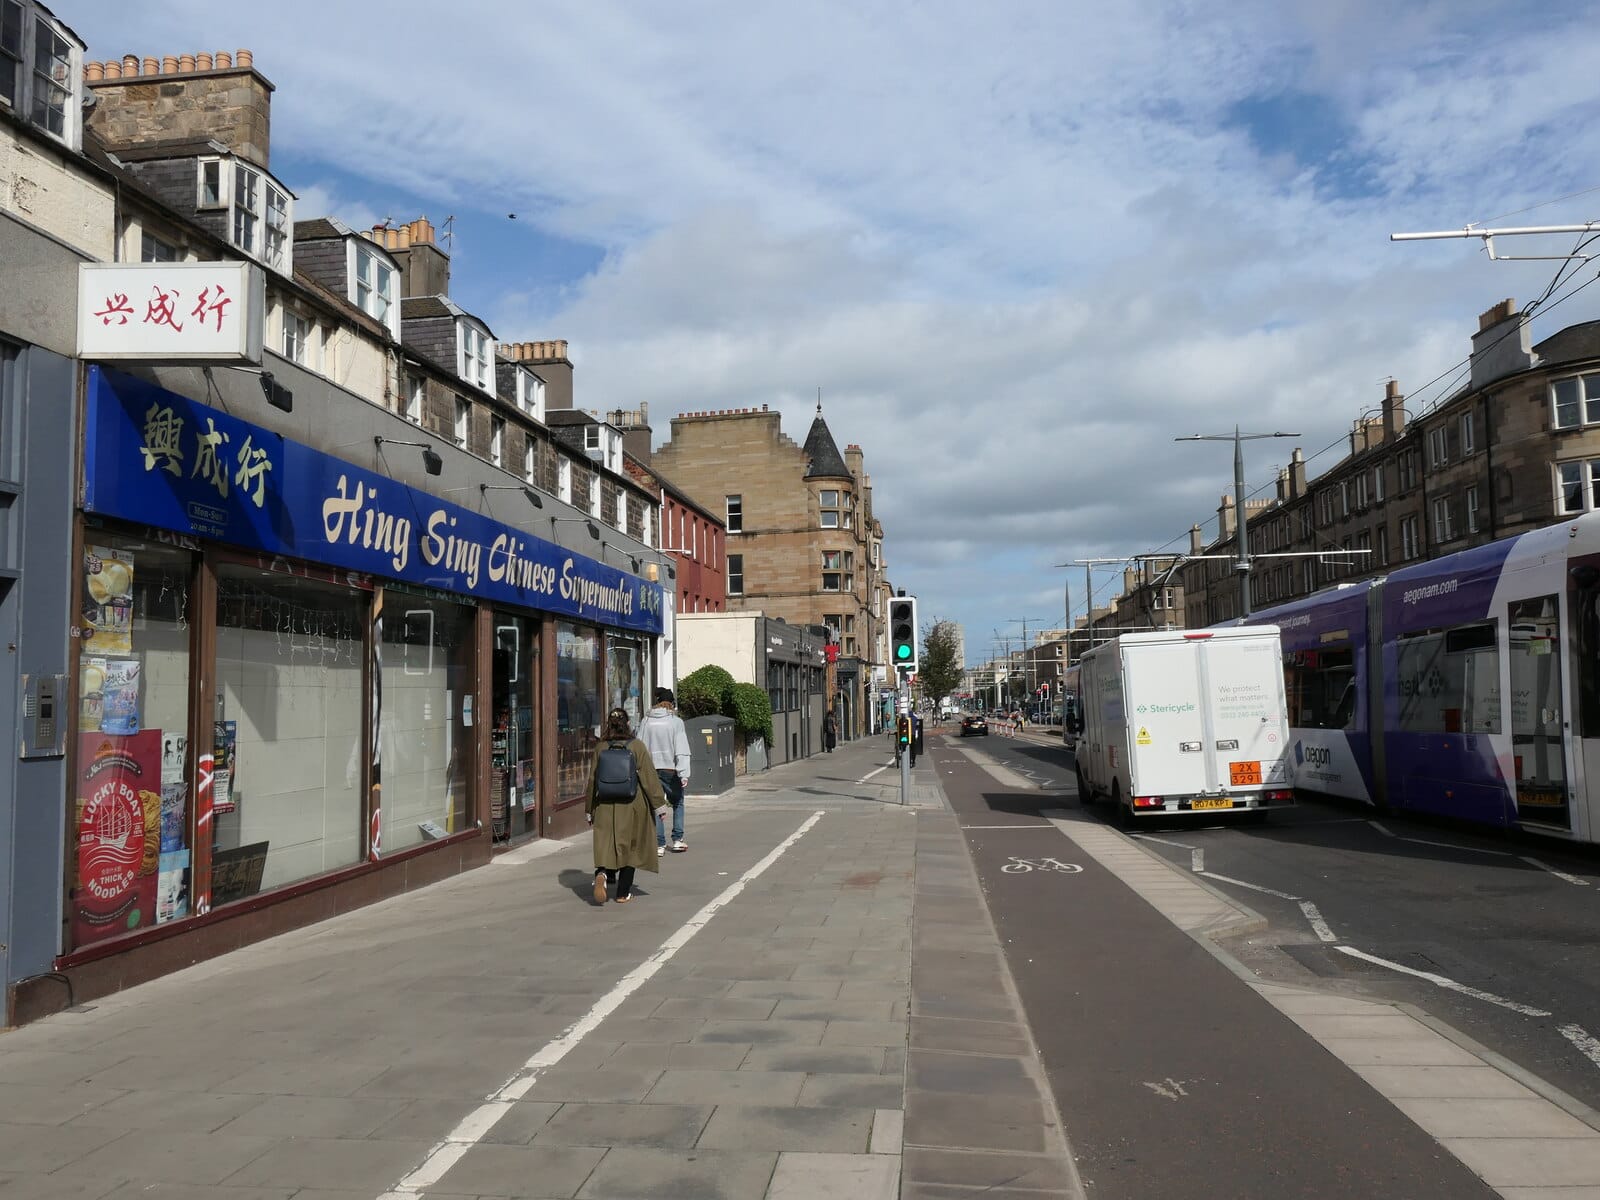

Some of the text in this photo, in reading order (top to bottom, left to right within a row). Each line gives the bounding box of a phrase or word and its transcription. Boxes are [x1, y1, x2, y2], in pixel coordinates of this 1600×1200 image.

[94, 284, 233, 333] 兴成行
[139, 401, 273, 509] 興成行
[322, 474, 633, 616] Hing Sing Chinese Supermarket
[1403, 577, 1458, 605] aegonam.com
[1232, 684, 1261, 694] protect
[1150, 702, 1195, 714] Stericycle
[1239, 763, 1253, 773] 2X
[1305, 746, 1331, 769] aegon
[1232, 774, 1261, 784] 3291
[84, 781, 142, 825] LUCKY BOAT
[87, 869, 135, 899] NOODLES
[100, 874, 124, 885] THICK
